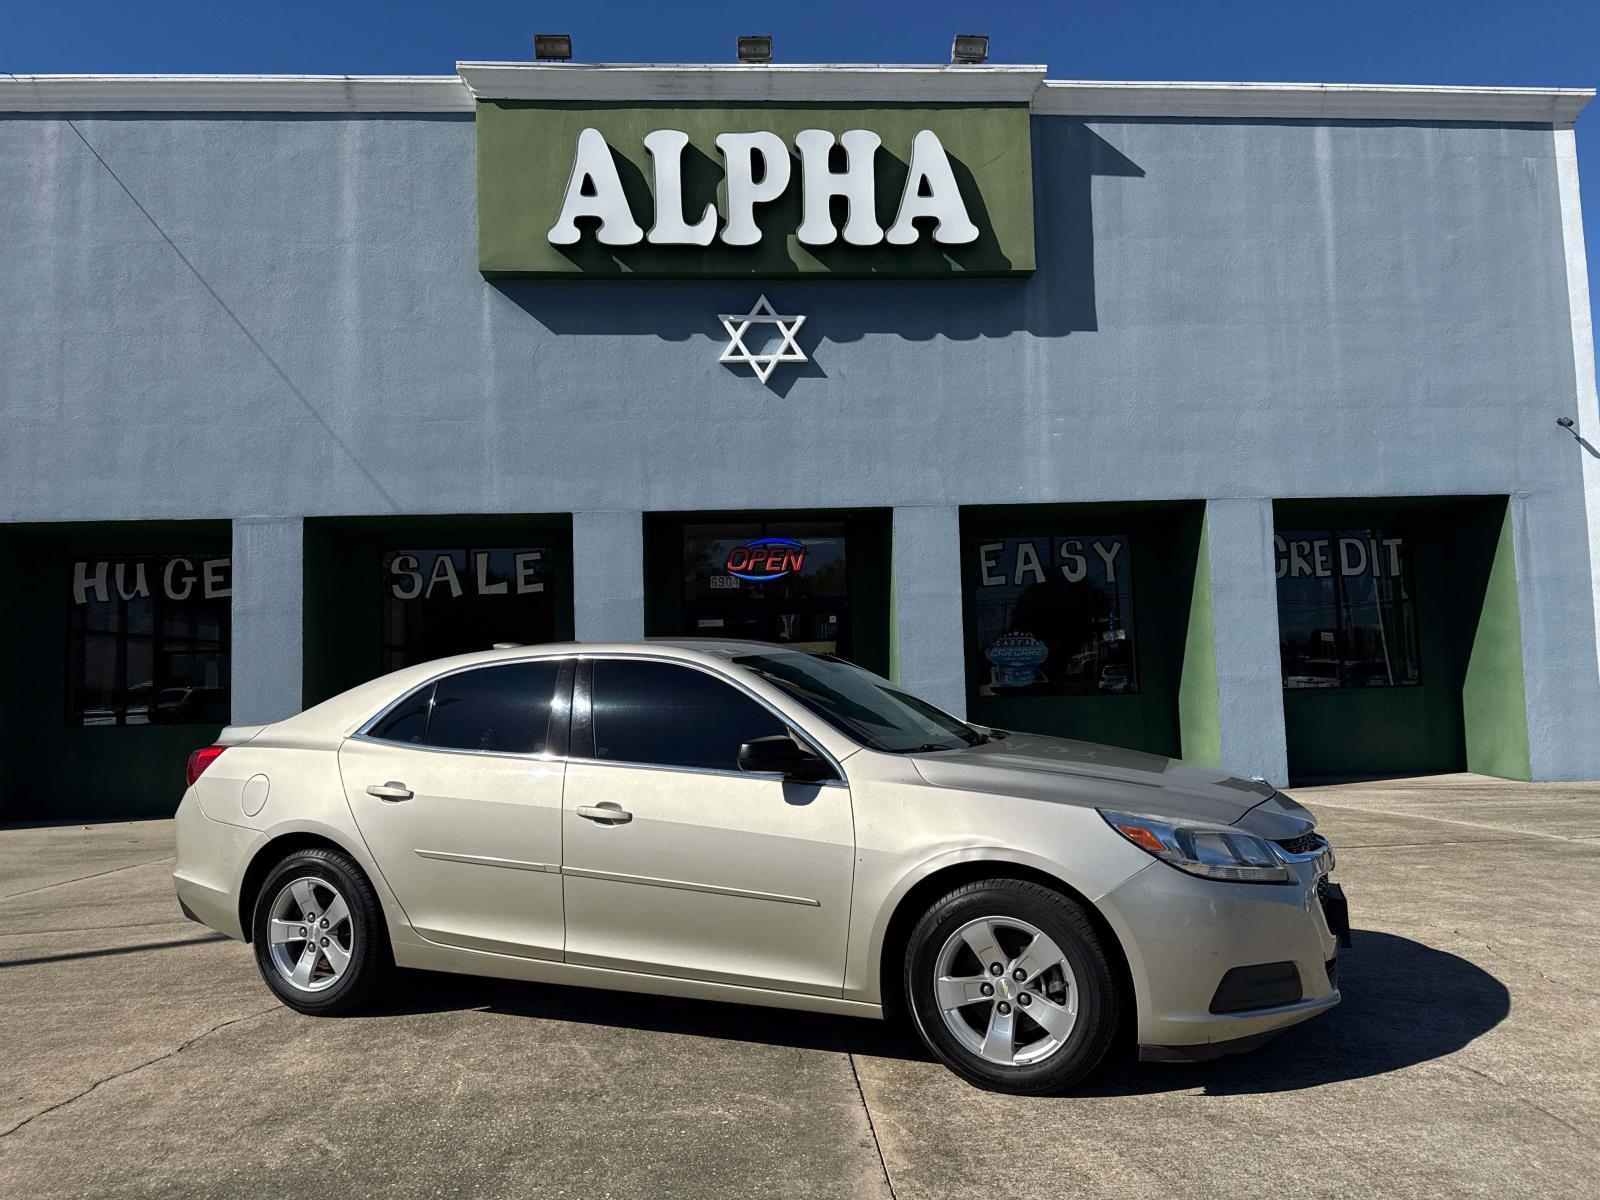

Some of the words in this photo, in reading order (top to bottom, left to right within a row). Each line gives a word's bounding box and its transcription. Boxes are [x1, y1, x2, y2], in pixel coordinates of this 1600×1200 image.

[547, 127, 980, 246] ALPHA
[390, 552, 545, 600] SALE
[726, 546, 806, 573] OPEN
[979, 539, 1122, 586] EASY
[1274, 534, 1403, 578] CREDIT
[72, 558, 232, 605] HUGE
